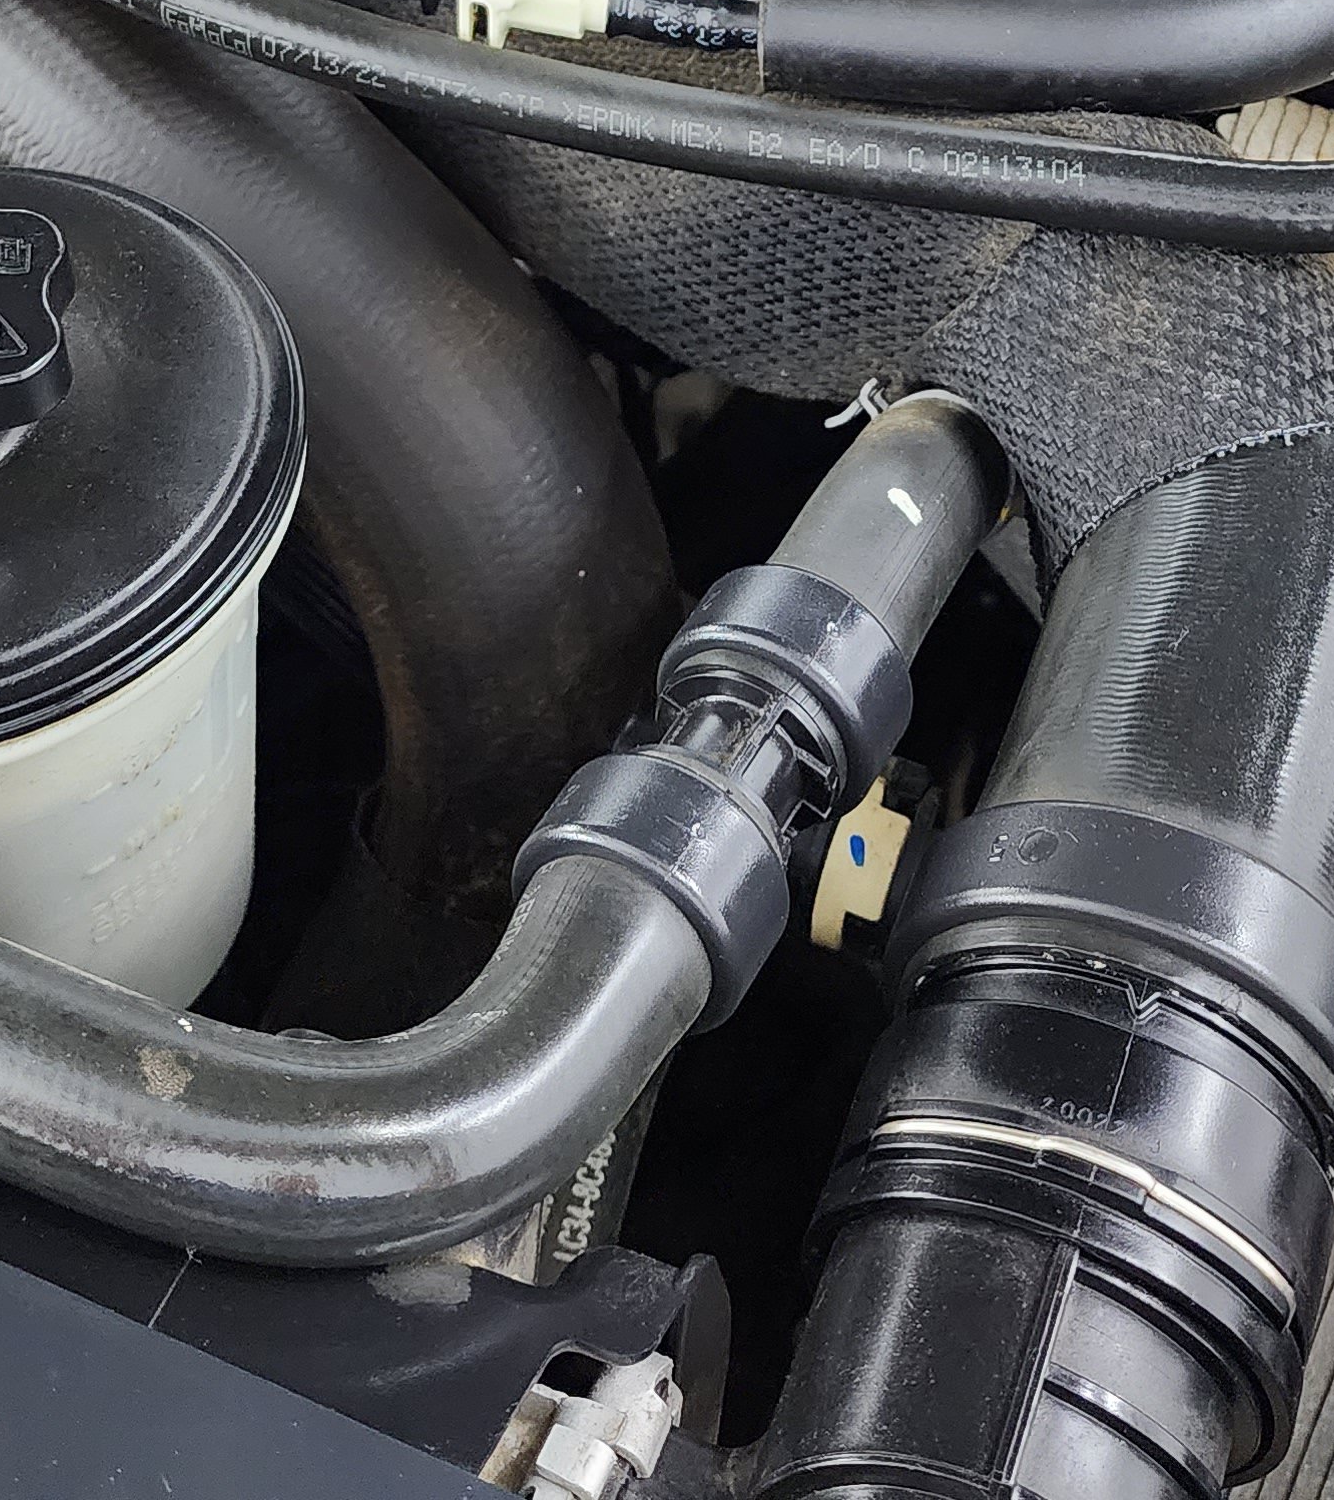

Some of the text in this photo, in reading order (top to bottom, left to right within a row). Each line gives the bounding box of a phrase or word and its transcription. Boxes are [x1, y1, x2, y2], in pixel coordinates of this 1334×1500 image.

[260, 35, 387, 90] 07/13/22
[670, 118, 725, 153] MEX
[748, 130, 784, 160] B2
[807, 136, 881, 170] EA/D
[906, 148, 925, 174] C
